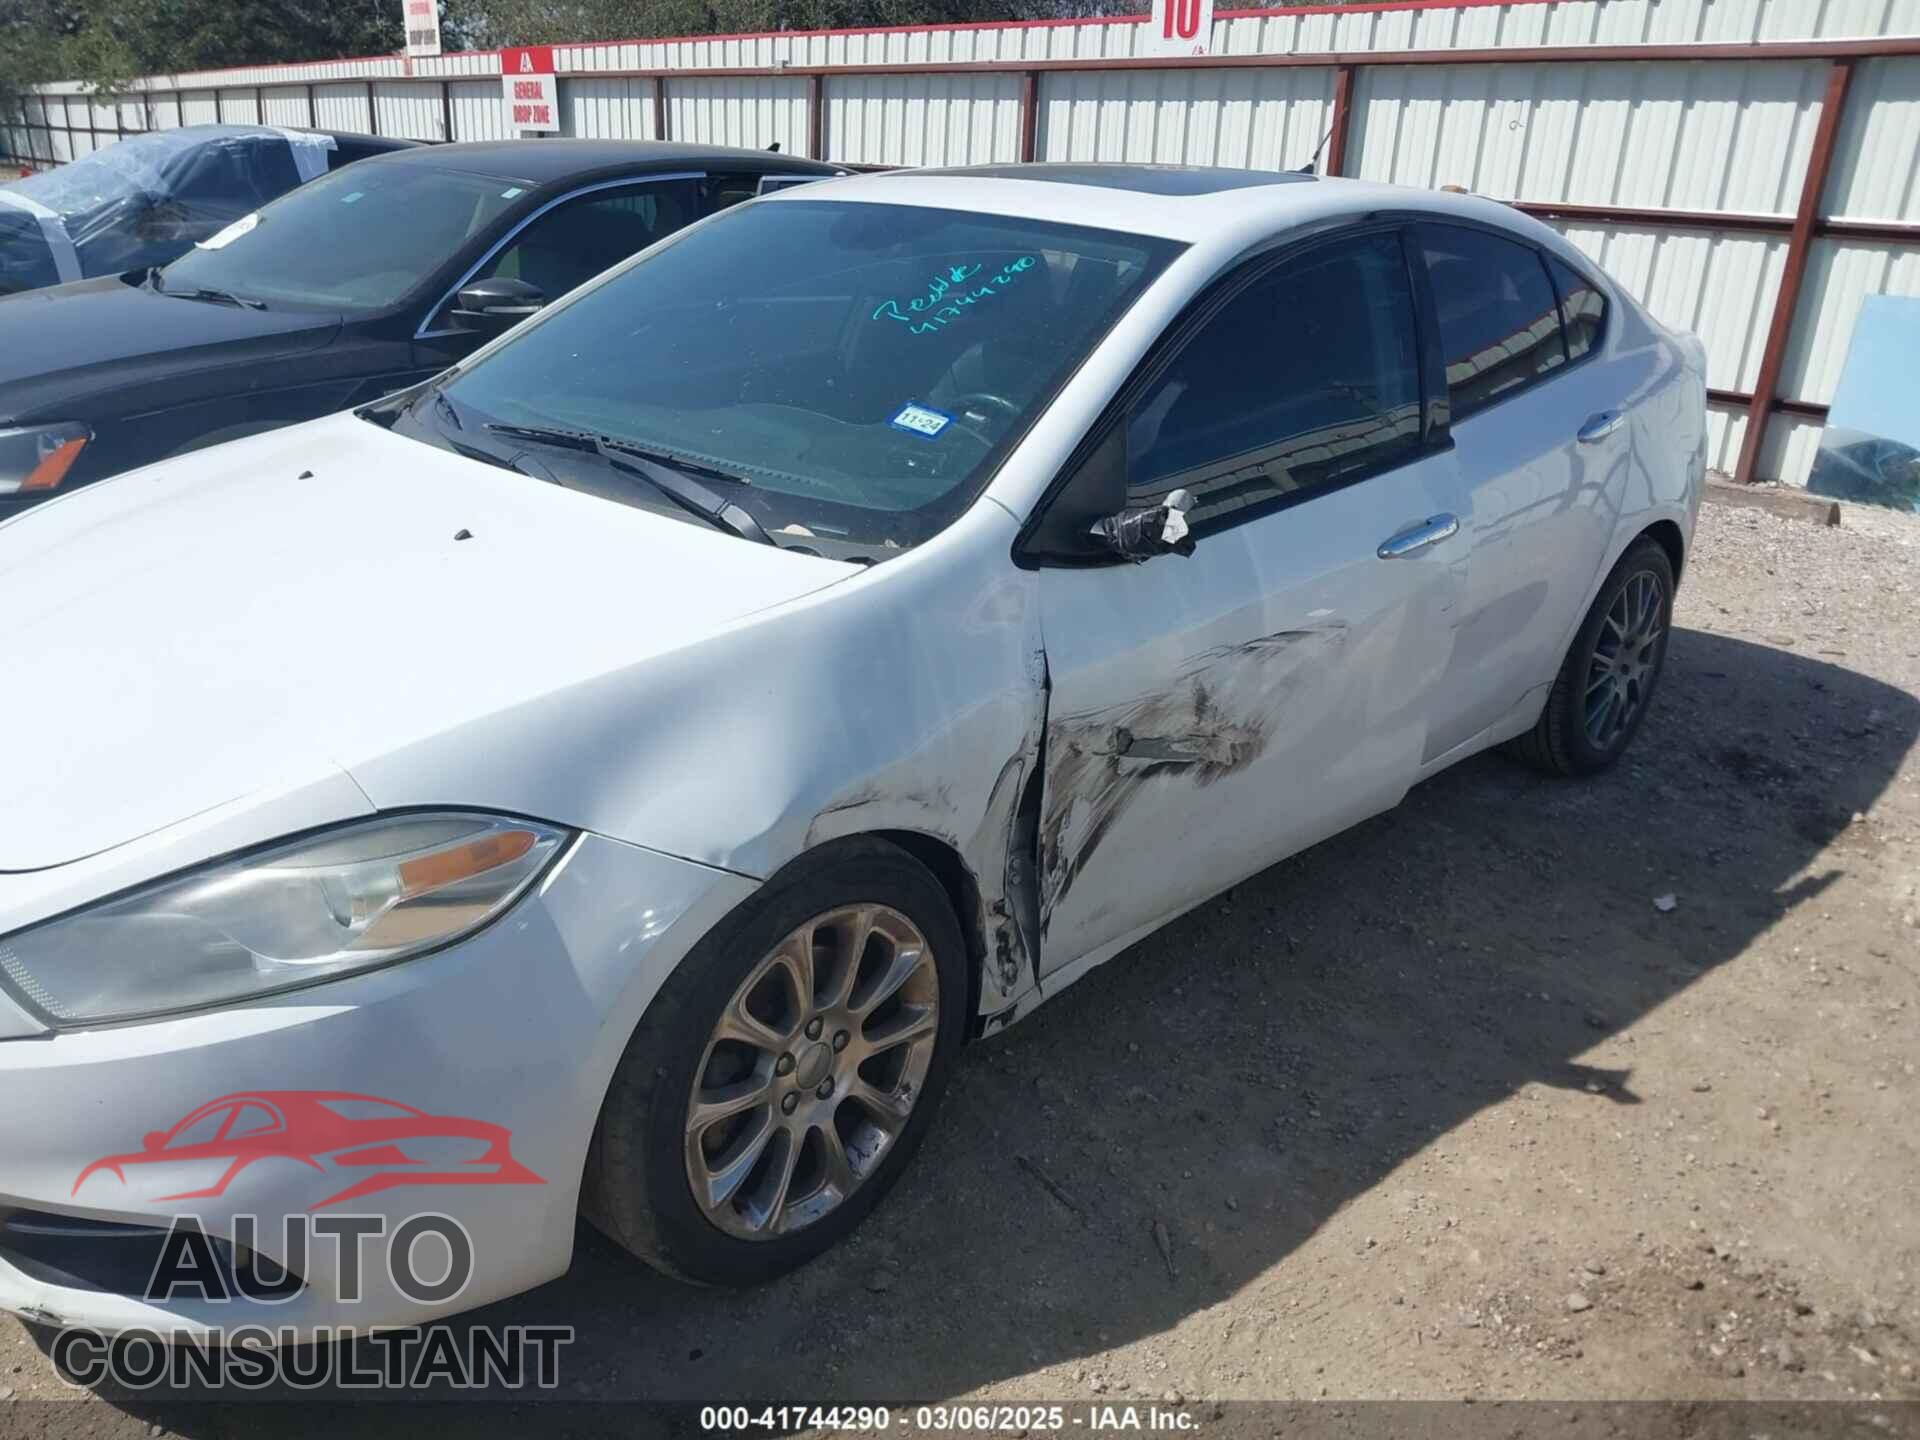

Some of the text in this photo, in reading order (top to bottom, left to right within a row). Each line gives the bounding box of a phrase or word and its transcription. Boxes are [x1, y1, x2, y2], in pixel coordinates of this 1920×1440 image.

[514, 81, 543, 99] GENERAL
[513, 104, 550, 124] DROP ZONE
